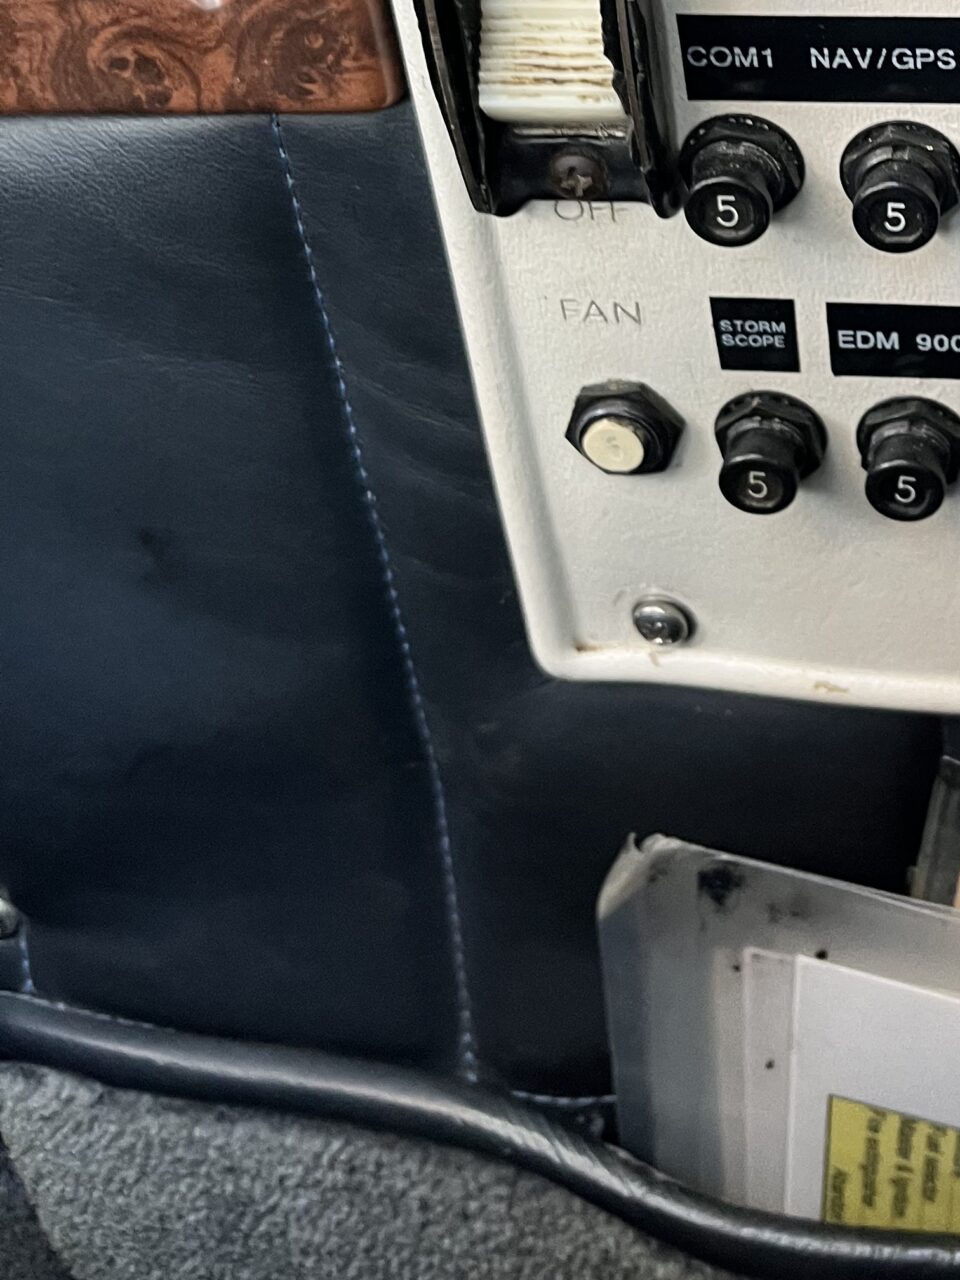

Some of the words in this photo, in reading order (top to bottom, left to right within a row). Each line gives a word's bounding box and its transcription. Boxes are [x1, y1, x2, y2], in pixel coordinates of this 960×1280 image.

[686, 46, 774, 68] COM1
[715, 194, 740, 228] 5
[883, 201, 907, 233] 5
[559, 299, 643, 327] FAN
[719, 319, 787, 335] STORM
[721, 333, 786, 348] SCOPE
[837, 329, 900, 351] EDM
[747, 471, 769, 499] 5
[894, 475, 917, 503] 5
